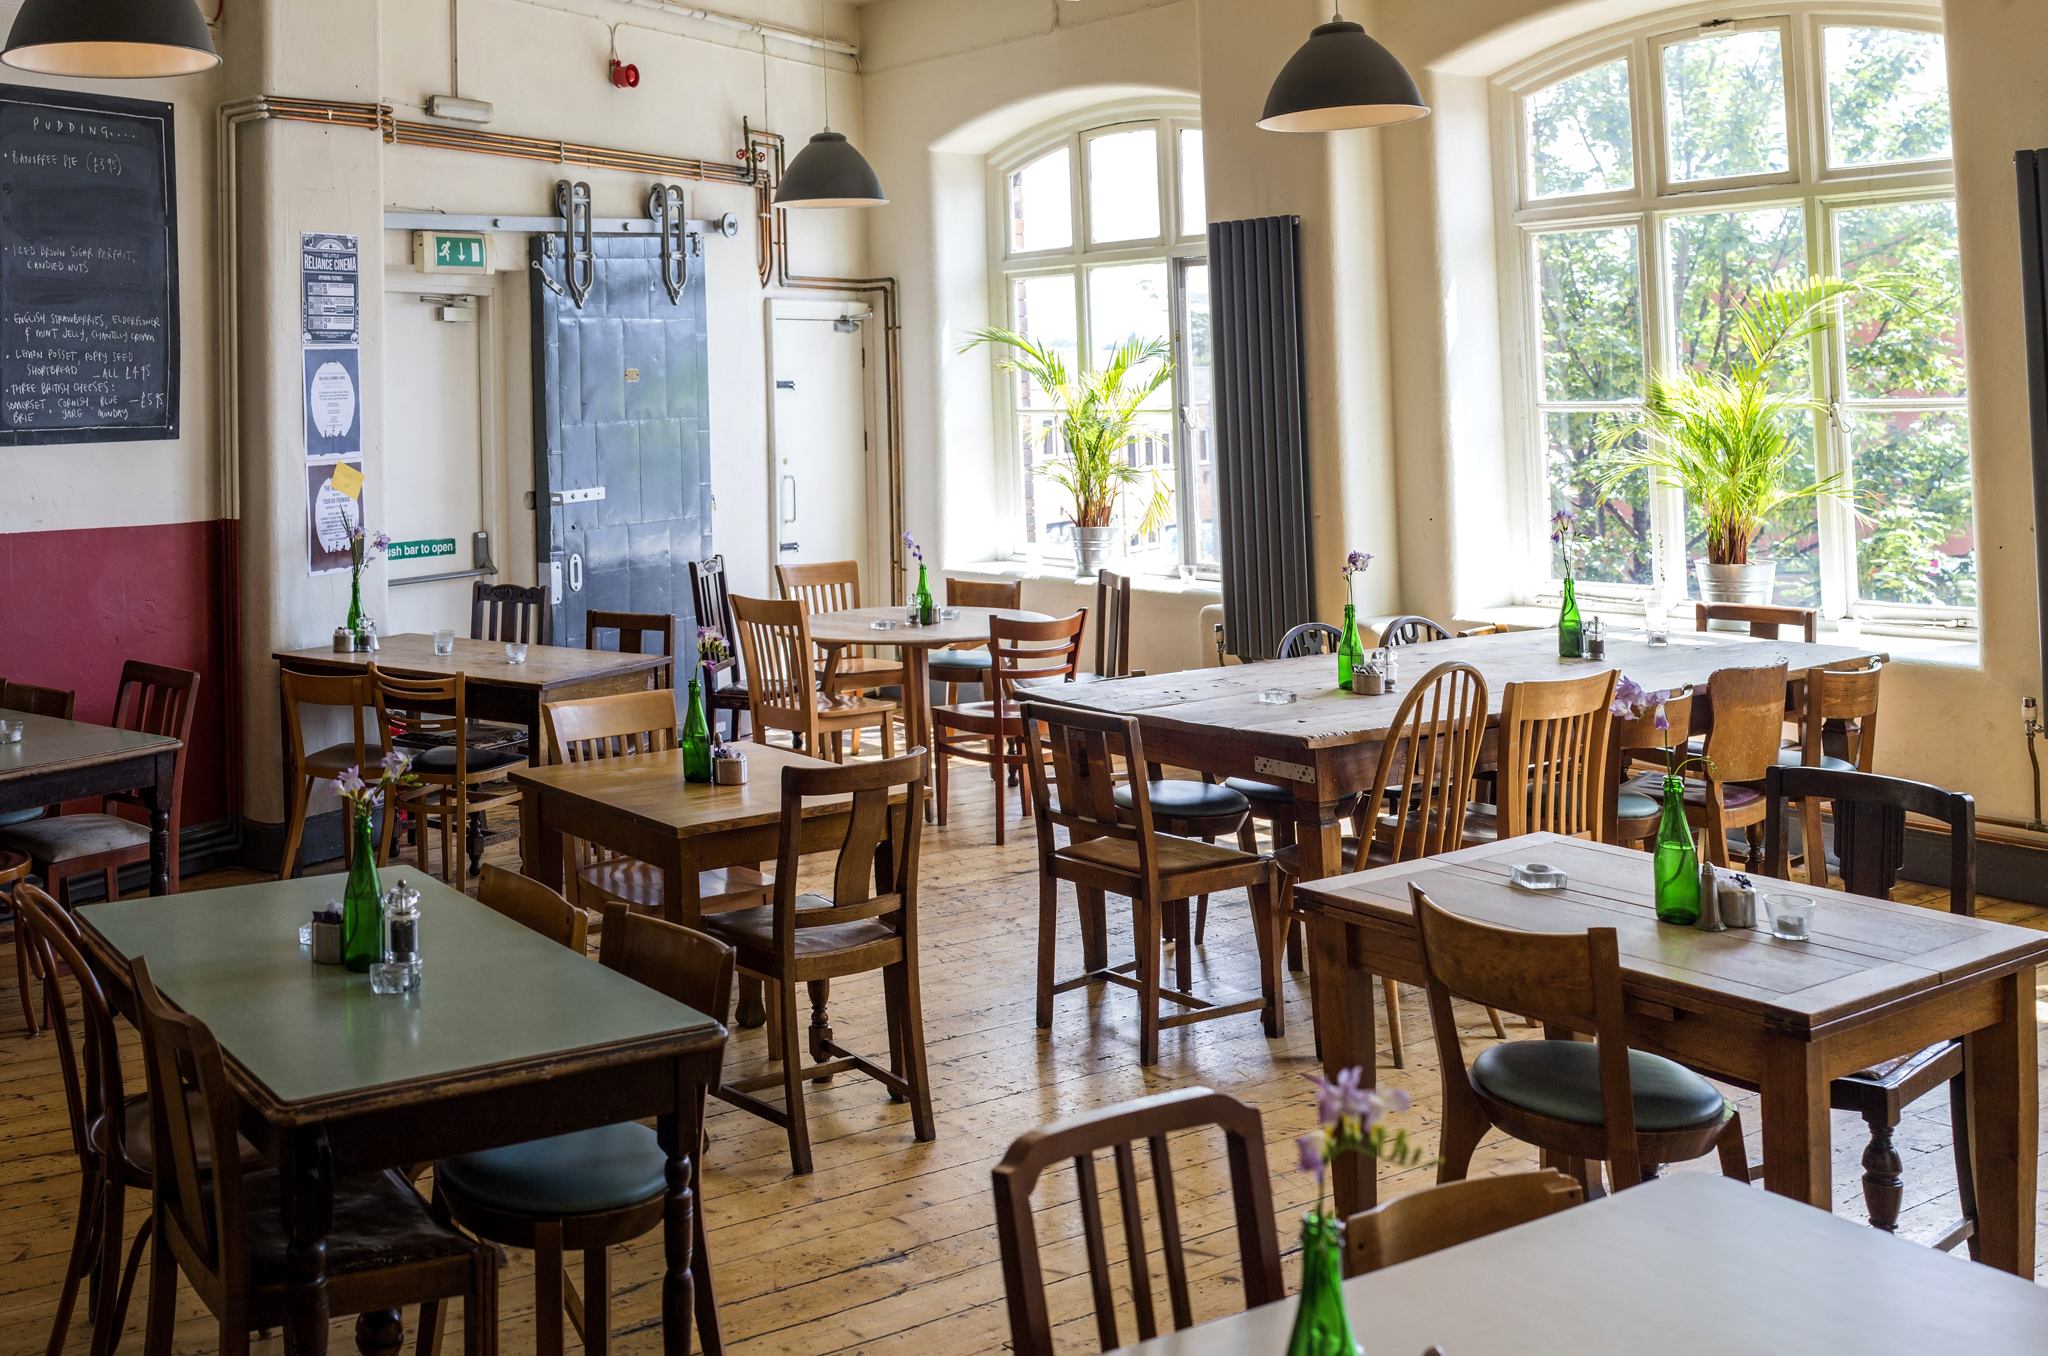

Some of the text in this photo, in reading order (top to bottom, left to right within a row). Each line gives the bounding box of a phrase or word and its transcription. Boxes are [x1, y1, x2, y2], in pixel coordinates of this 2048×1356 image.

[63, 154, 78, 169] PIE
[13, 244, 36, 257] ICED
[40, 245, 65, 258] BROWN
[27, 260, 89, 273] CANDIED NUTS
[304, 254, 356, 271] RELIANCE CINEMA
[13, 311, 46, 324] ENGLISH
[111, 314, 161, 328] ELDERFLOWER
[35, 327, 59, 339] MINT
[91, 329, 128, 343] CHANTILLY
[130, 332, 155, 342] CREAM
[15, 349, 43, 359] LEMON
[84, 350, 108, 364] POPPY
[112, 351, 134, 362] SEED
[26, 363, 78, 376] SHORTBREAD
[102, 367, 119, 379] ALL
[10, 382, 37, 395] THREE
[41, 382, 70, 395] BRITISH
[6, 398, 47, 411] SOMERSET
[57, 396, 89, 408] CORNISH
[99, 395, 118, 407] BLUE
[13, 407, 129, 424] BRIE YARG MONDAY
[404, 545, 418, 556] bar
[420, 544, 430, 554] to
[432, 543, 453, 555] open
